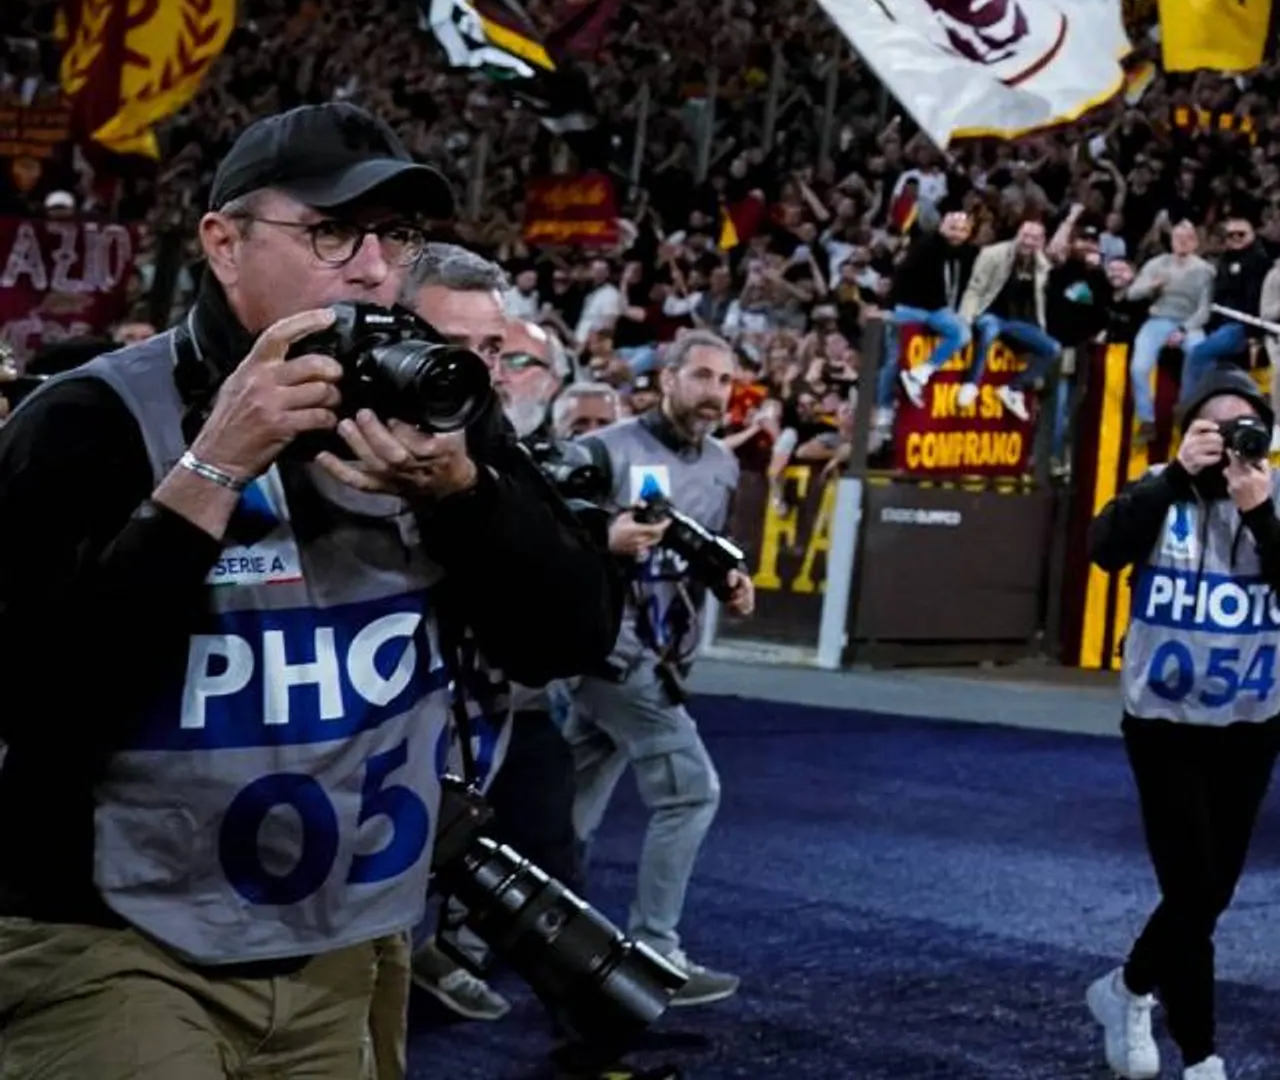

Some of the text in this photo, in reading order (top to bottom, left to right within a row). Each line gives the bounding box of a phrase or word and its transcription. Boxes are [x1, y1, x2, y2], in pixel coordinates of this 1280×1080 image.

[905, 430, 1024, 470] COMPRANO
[214, 555, 284, 576] SERIE A
[179, 611, 445, 730] PHO
[1147, 638, 1278, 708] 054
[219, 722, 449, 905] 05
